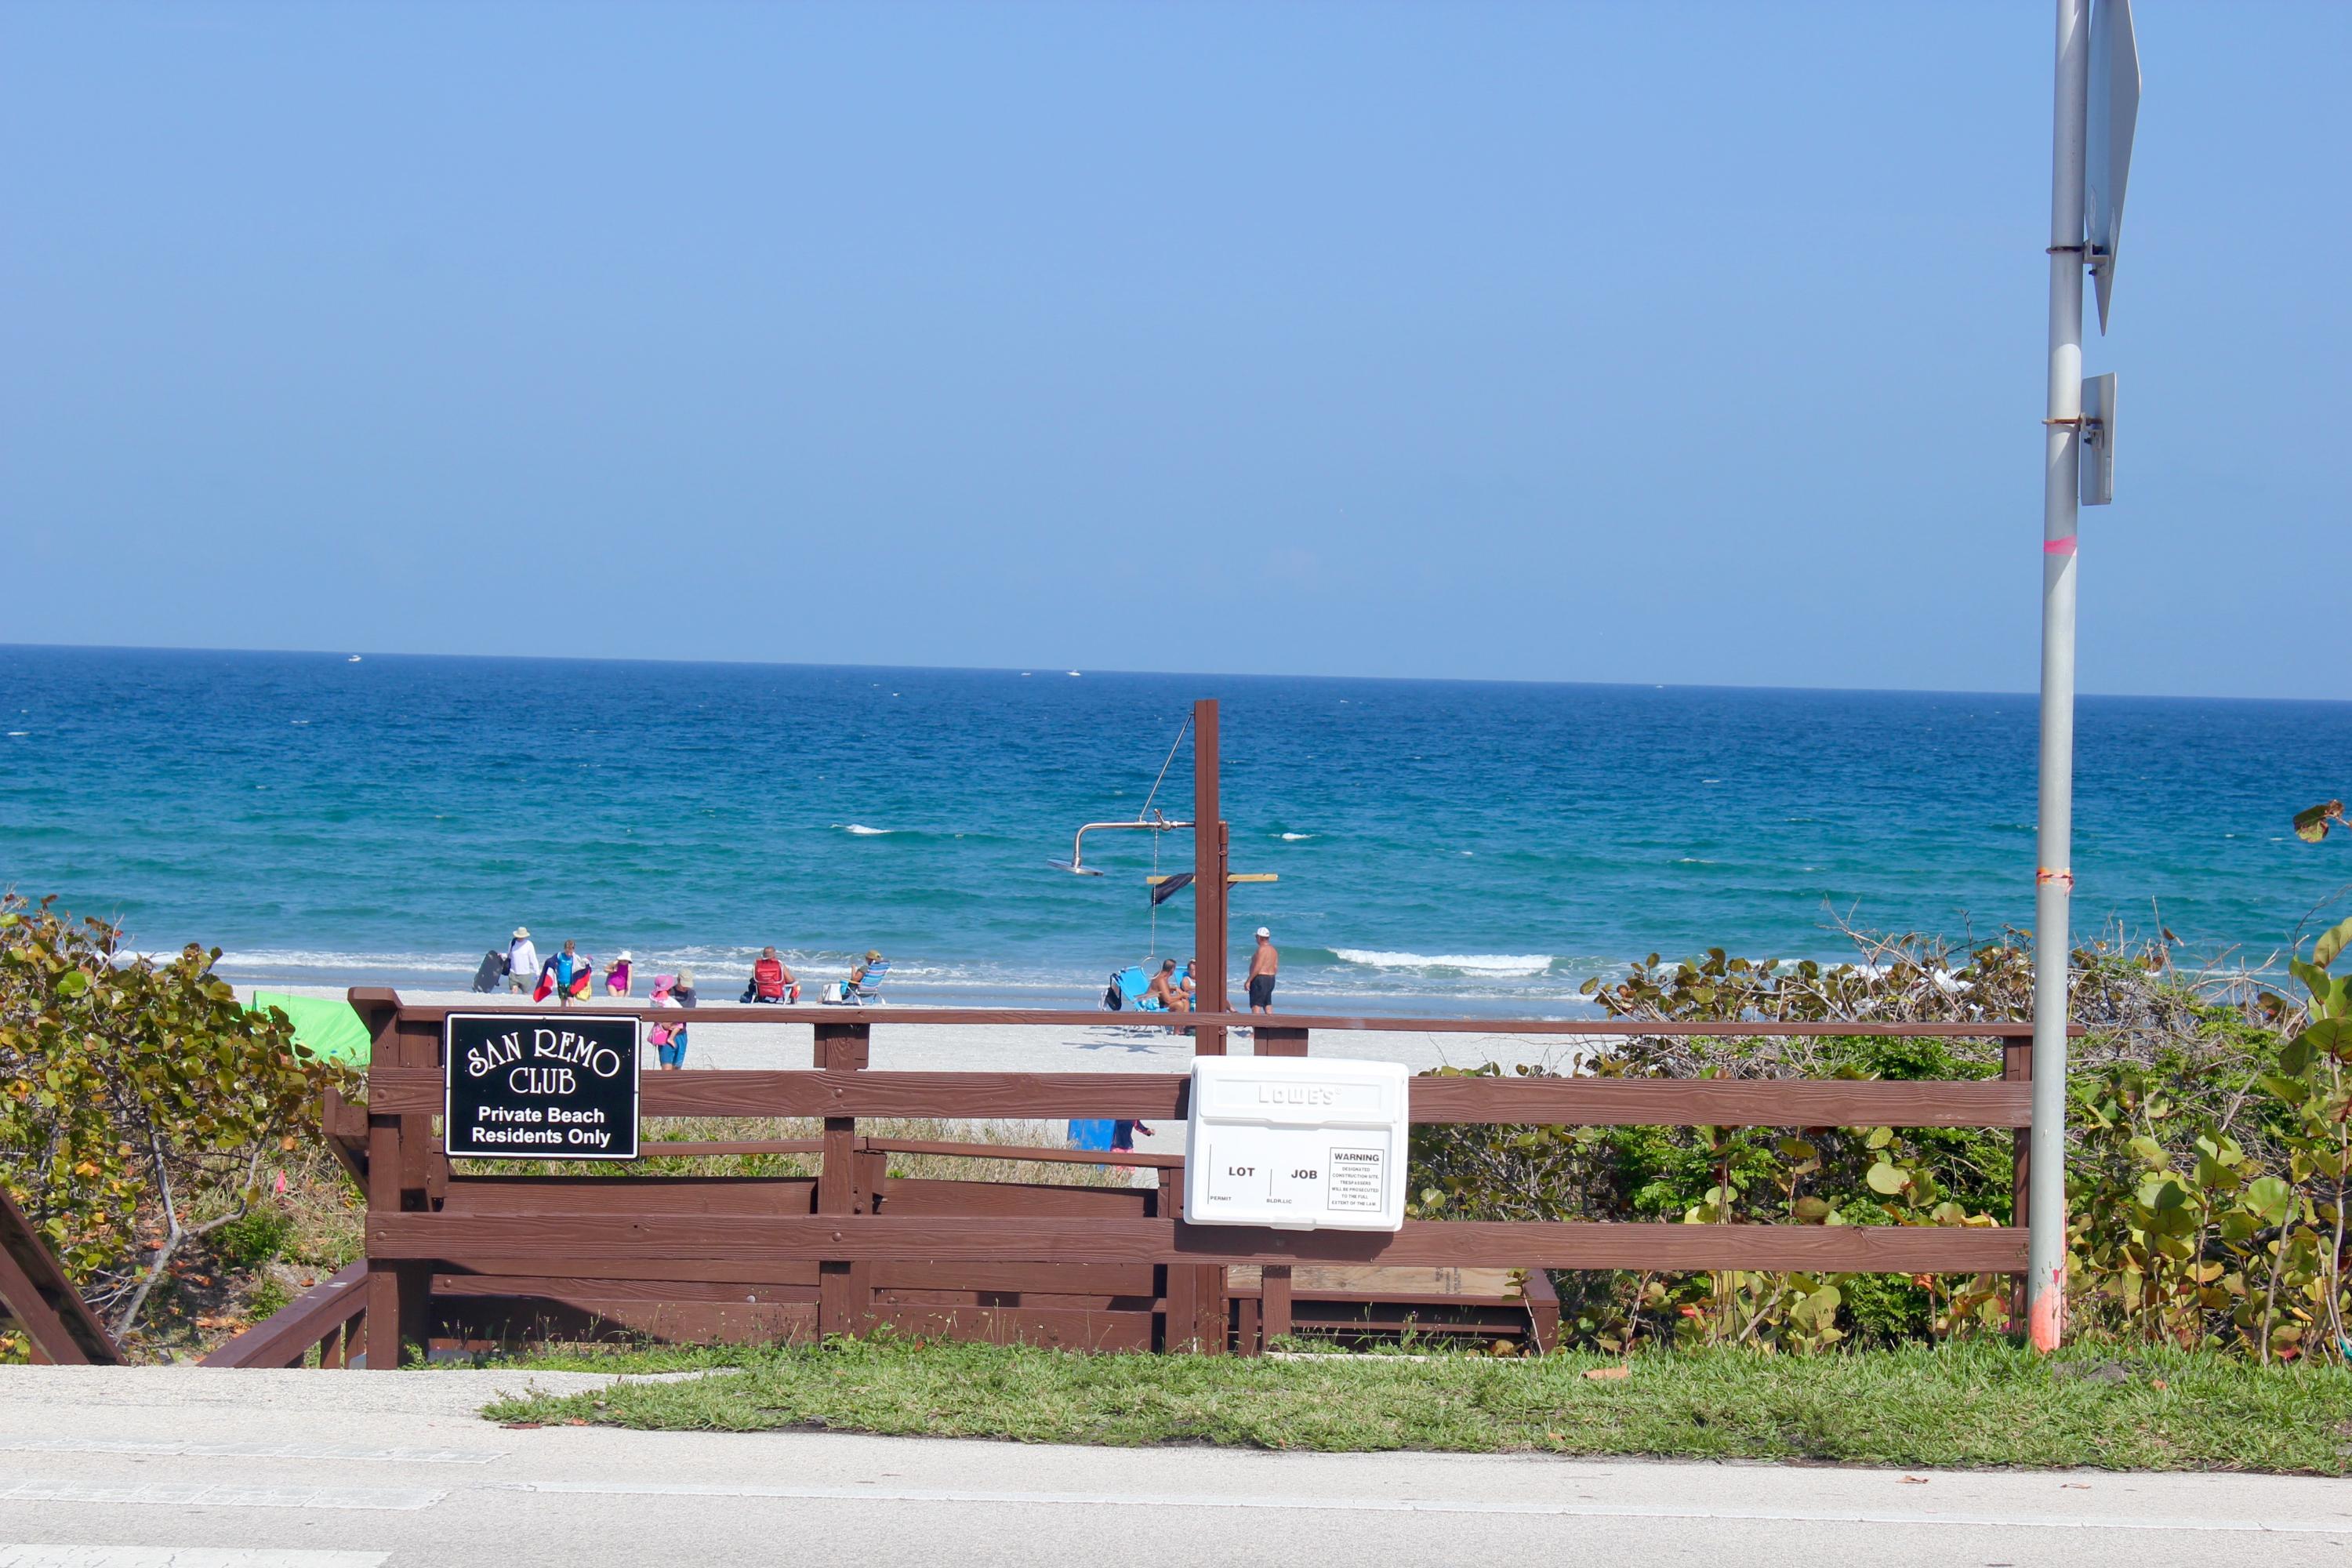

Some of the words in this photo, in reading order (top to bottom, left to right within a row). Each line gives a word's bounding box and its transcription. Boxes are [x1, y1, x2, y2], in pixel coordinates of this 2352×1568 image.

[467, 1032, 521, 1077] SAN
[534, 1029, 620, 1077] REMO
[509, 1066, 576, 1094] CLUB
[1258, 1084, 1334, 1105] LOWE'S
[478, 1106, 543, 1123] Private
[548, 1107, 605, 1123] Beach
[472, 1127, 563, 1144] Residents
[568, 1128, 612, 1148] Only
[1334, 1152, 1380, 1162] WARNING
[1229, 1167, 1255, 1177] LOT
[1290, 1169, 1318, 1179] JOB
